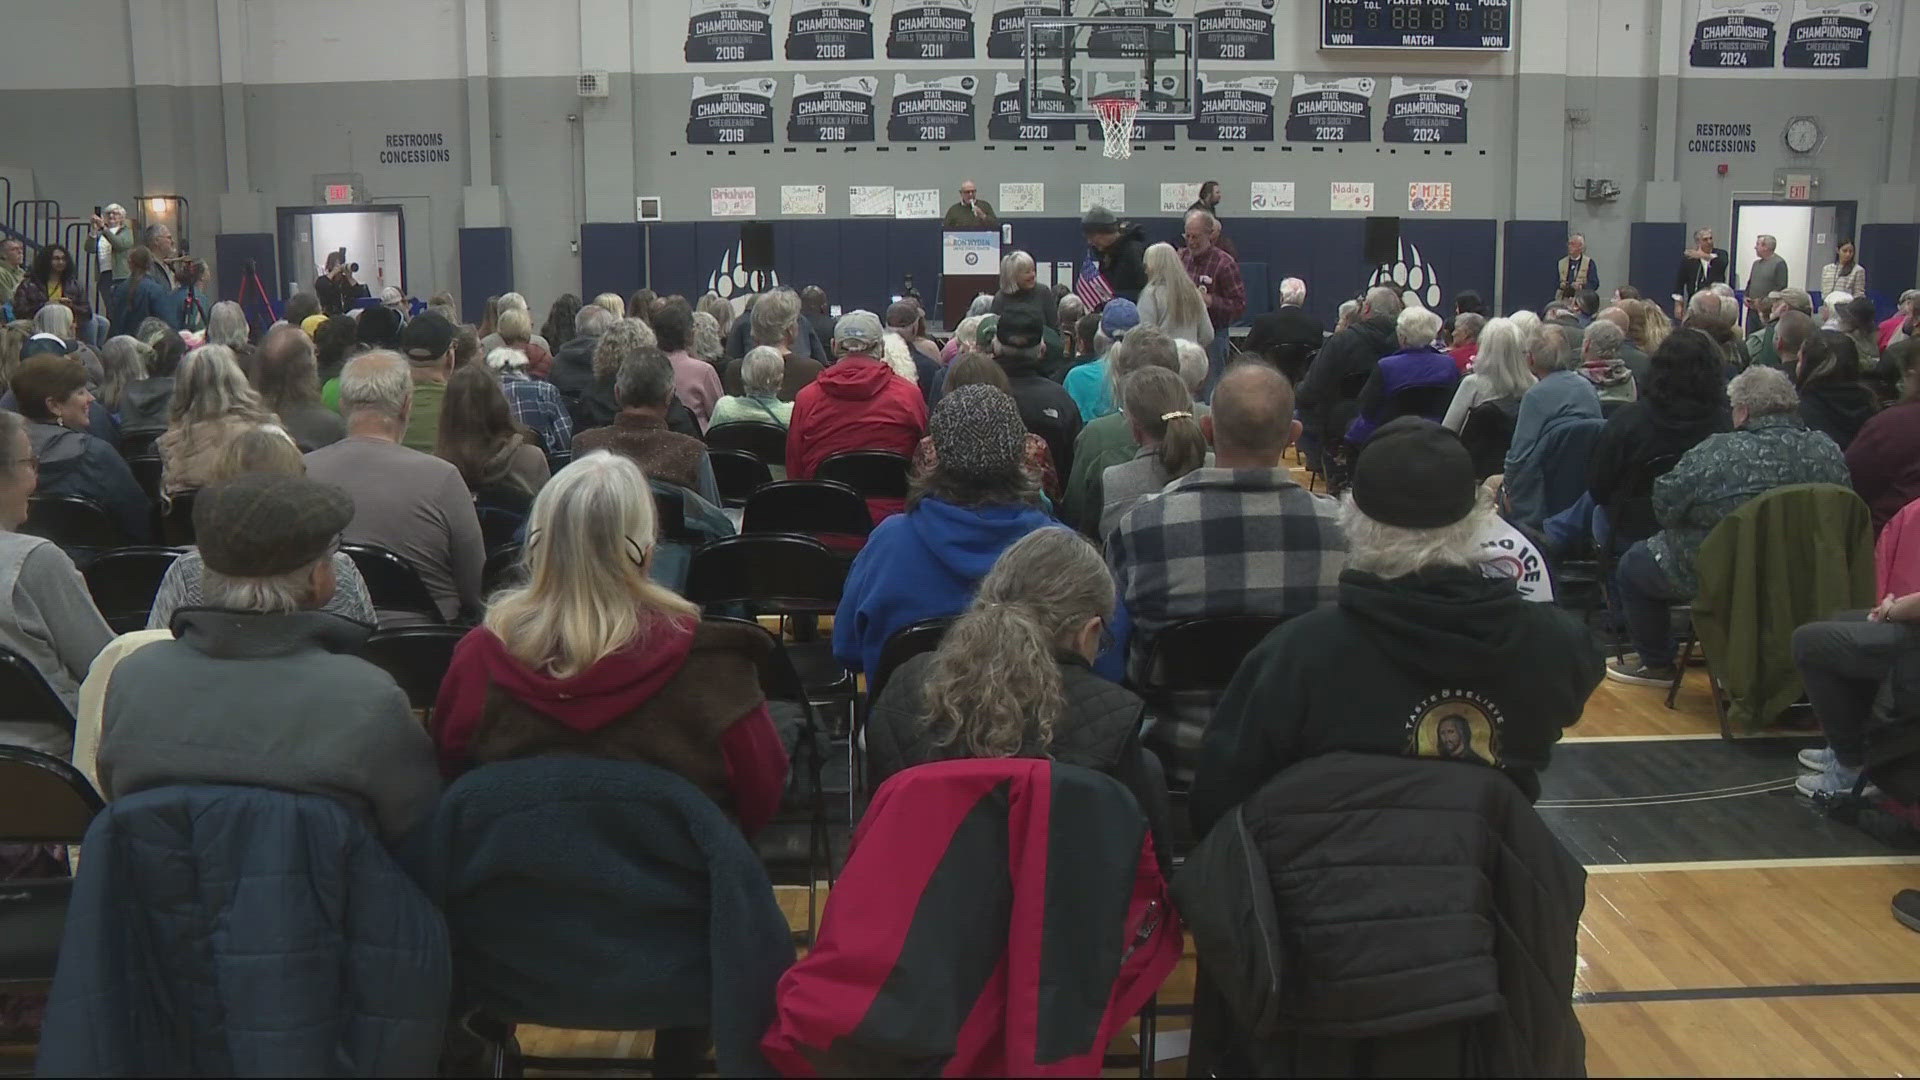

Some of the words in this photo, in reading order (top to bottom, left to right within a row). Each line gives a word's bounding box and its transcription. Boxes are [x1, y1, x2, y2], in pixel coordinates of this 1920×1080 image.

[720, 10, 738, 19] STATE
[821, 9, 839, 17] STATE
[923, 8, 940, 17] STATE
[1024, 8, 1042, 16] STATE
[1224, 9, 1242, 17] STATE
[696, 19, 764, 33] CHAMPIONSHIP
[797, 18, 865, 32] CHAMPIONSHIP
[898, 17, 966, 32] CHAMPIONSHIP
[1200, 18, 1267, 32] CHAMPIONSHIP
[1727, 17, 1744, 25] STATE
[1821, 17, 1838, 25] STATE
[1332, 34, 1353, 44] WON
[1703, 26, 1768, 39] CHAMPIONSHIP
[1796, 26, 1862, 40] CHAMPIONSHIP
[1402, 35, 1434, 45] MATCH
[1482, 36, 1503, 46] WON
[716, 46, 744, 60] 2006
[816, 45, 845, 58] 2008
[921, 44, 943, 57] 2011
[1220, 44, 1246, 58] 2018
[1720, 52, 1747, 66] 2024
[1813, 53, 1841, 66] 2025
[722, 93, 740, 102] STATE
[823, 91, 841, 100] STATE
[924, 91, 942, 100] STATE
[1224, 91, 1242, 99] STATE
[1321, 92, 1339, 100] STATE
[1419, 94, 1436, 102] STATE
[697, 102, 765, 117] CHAMPIONSHIP
[798, 100, 866, 114] CHAMPIONSHIP
[899, 100, 967, 114] CHAMPIONSHIP
[1297, 100, 1364, 114] CHAMPIONSHIP
[1395, 102, 1460, 116] CHAMPIONSHIP
[719, 128, 744, 142] 2019
[820, 127, 846, 140] 2019
[920, 126, 946, 140] 2019
[1020, 126, 1048, 139] 2020
[1218, 126, 1246, 139] 2023
[1316, 128, 1344, 140] 2023
[1413, 128, 1440, 142] 2024
[1696, 124, 1752, 136] RESTROOMS
[386, 133, 443, 147] RESTROOMS
[1688, 140, 1756, 152] CONCESSIONS
[380, 150, 450, 164] CONCESSIONS
[1333, 184, 1359, 194] Nadia
[1790, 185, 1806, 198] EXIT
[1518, 546, 1540, 582] ICE
[1455, 689, 1504, 724] BELIEVE
